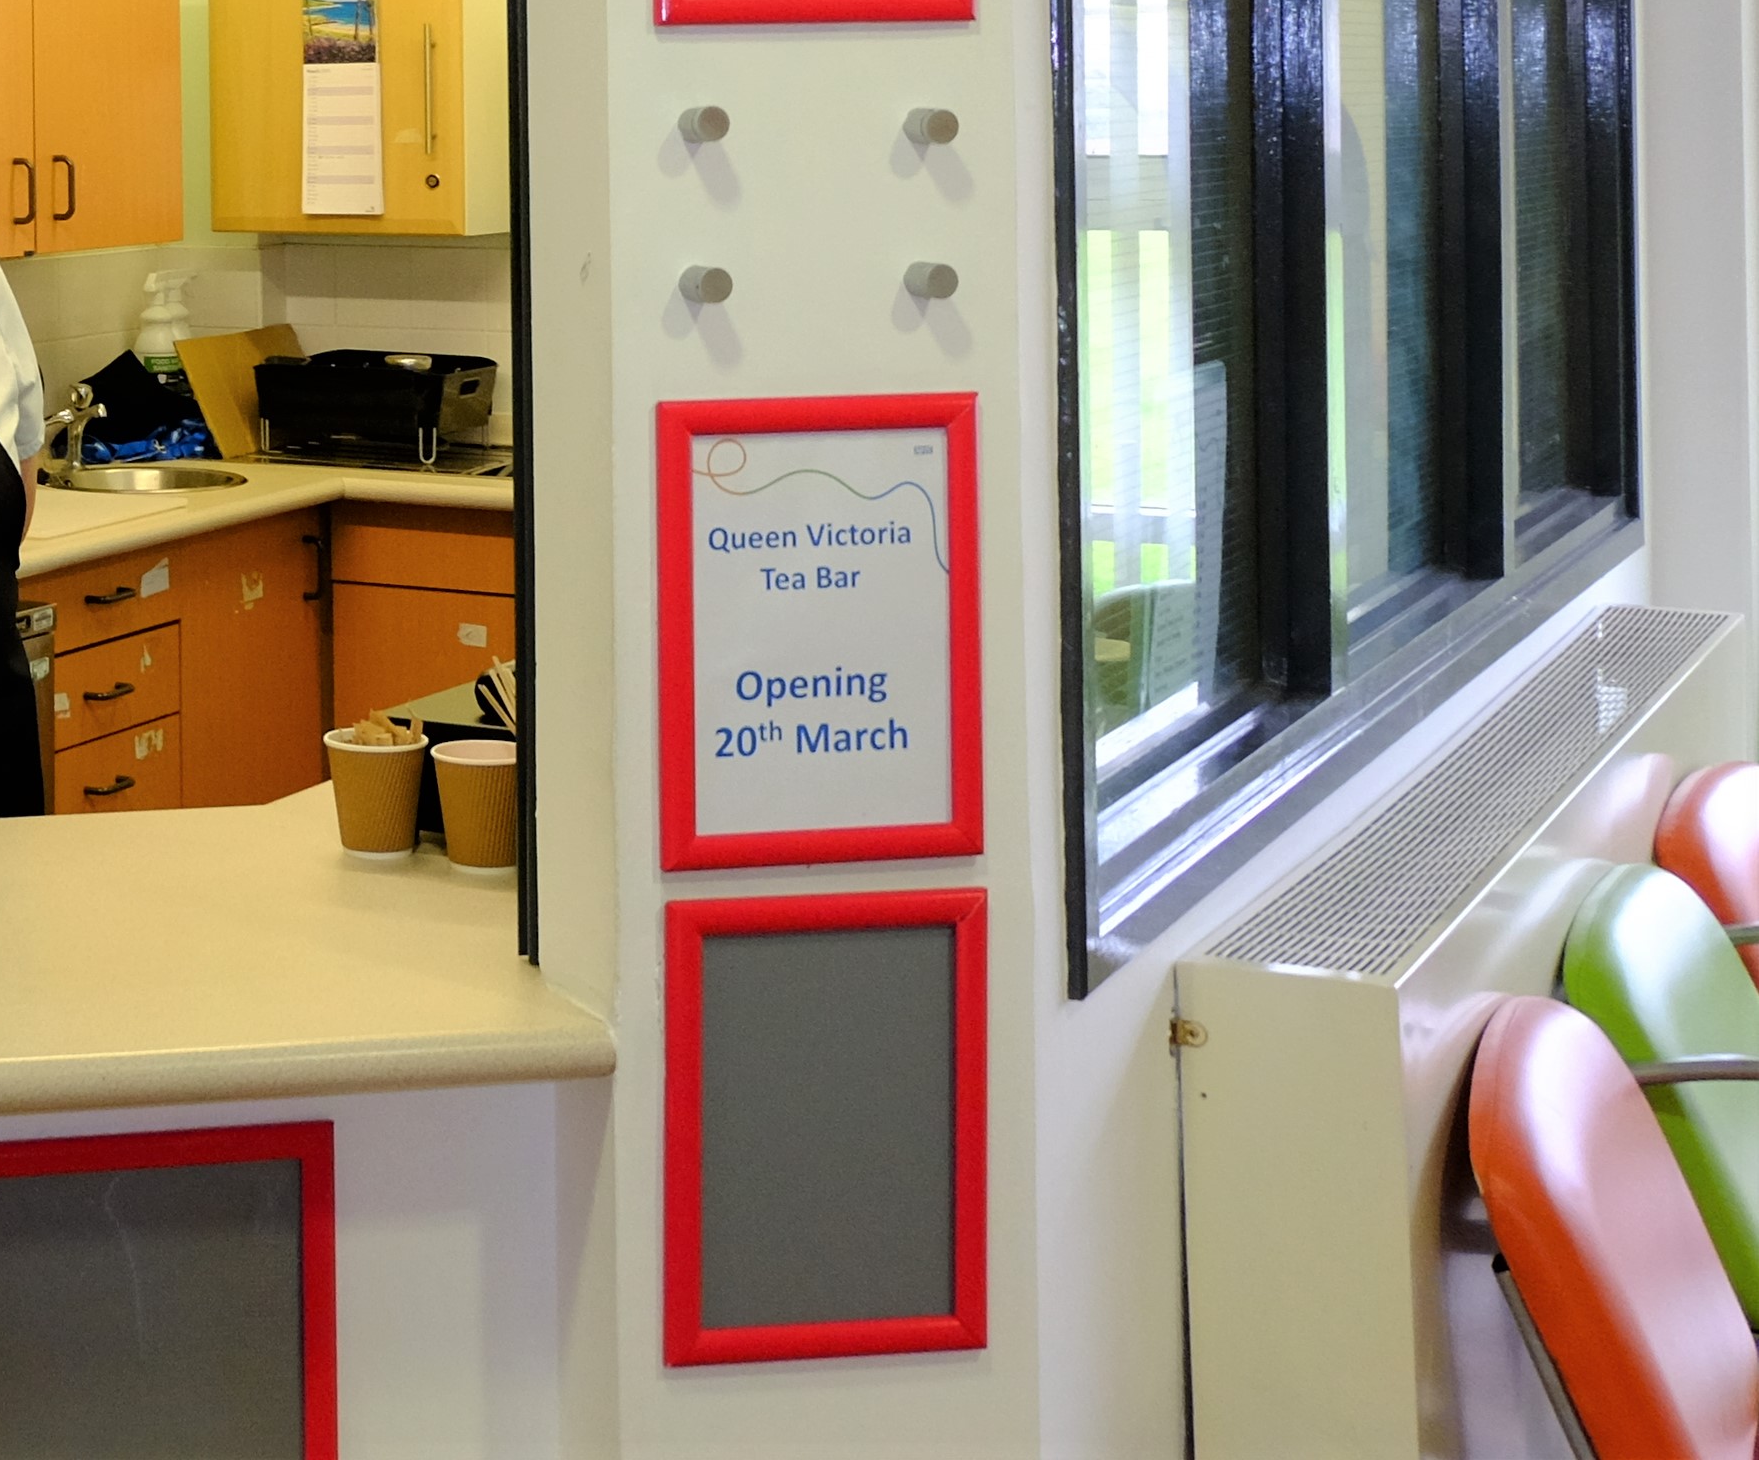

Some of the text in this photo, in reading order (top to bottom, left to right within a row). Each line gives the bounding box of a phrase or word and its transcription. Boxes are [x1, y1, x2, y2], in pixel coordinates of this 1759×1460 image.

[708, 520, 911, 554] Queen Victoria
[759, 566, 861, 591] Tea Bar
[736, 666, 888, 708] Opening
[715, 718, 908, 758] 20th March
